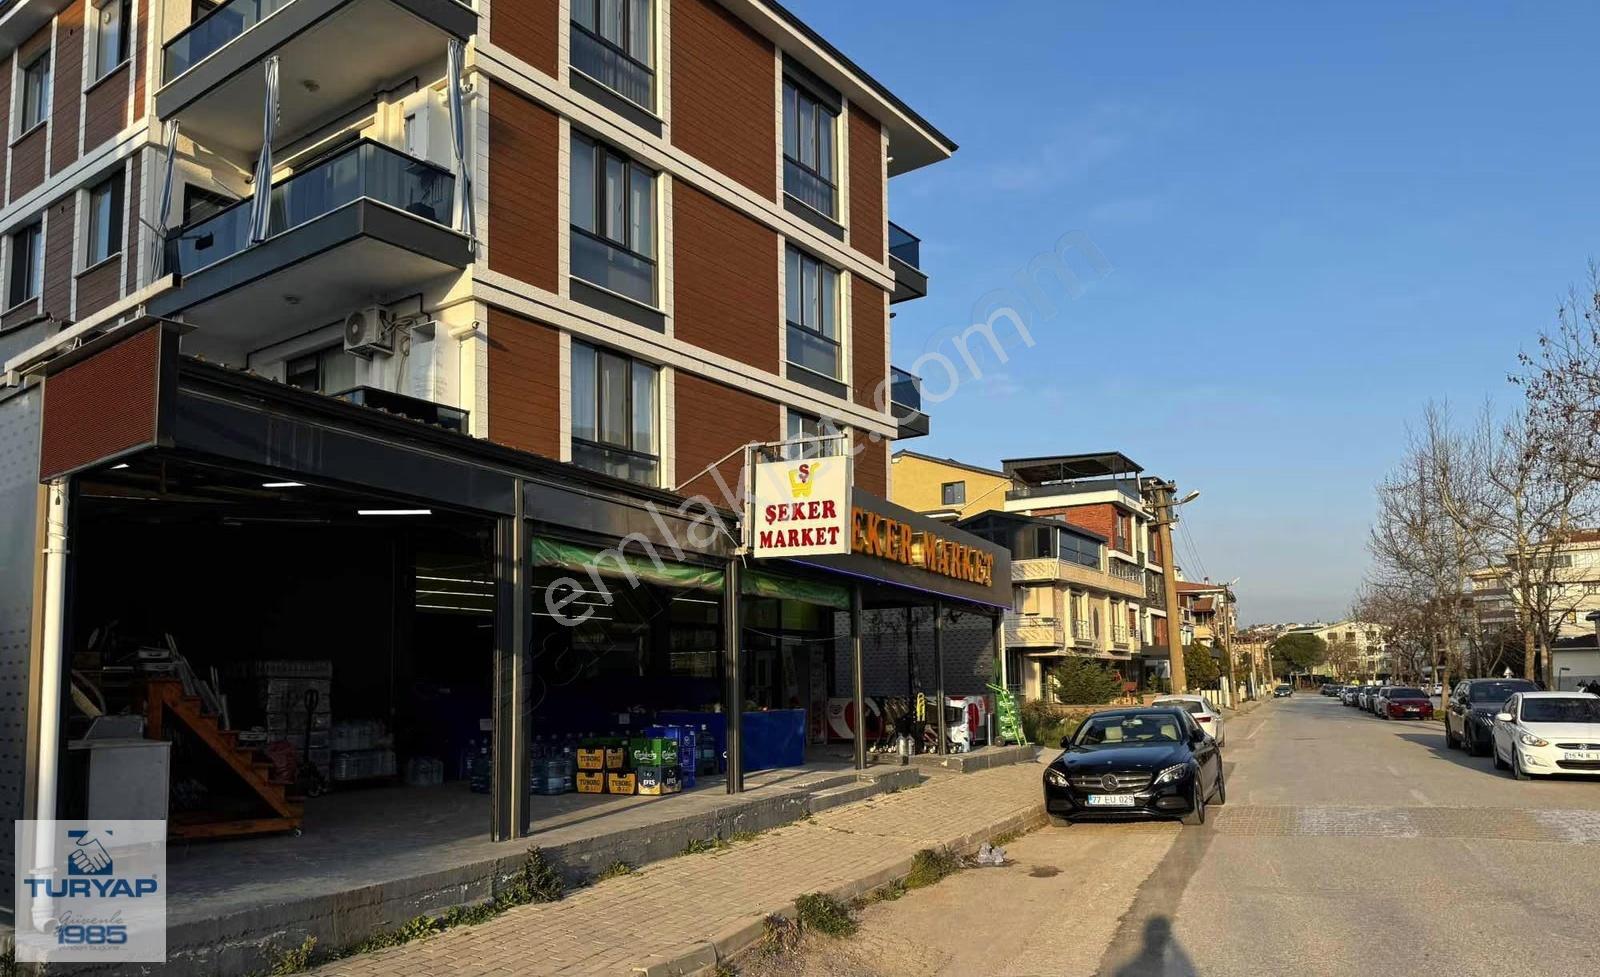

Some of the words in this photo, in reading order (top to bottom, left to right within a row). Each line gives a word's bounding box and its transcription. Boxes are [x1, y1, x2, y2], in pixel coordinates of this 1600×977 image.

[765, 500, 837, 525] ŞEKER
[759, 526, 840, 549] MARKET
[851, 506, 913, 565] EKER
[922, 531, 994, 588] MARKET
